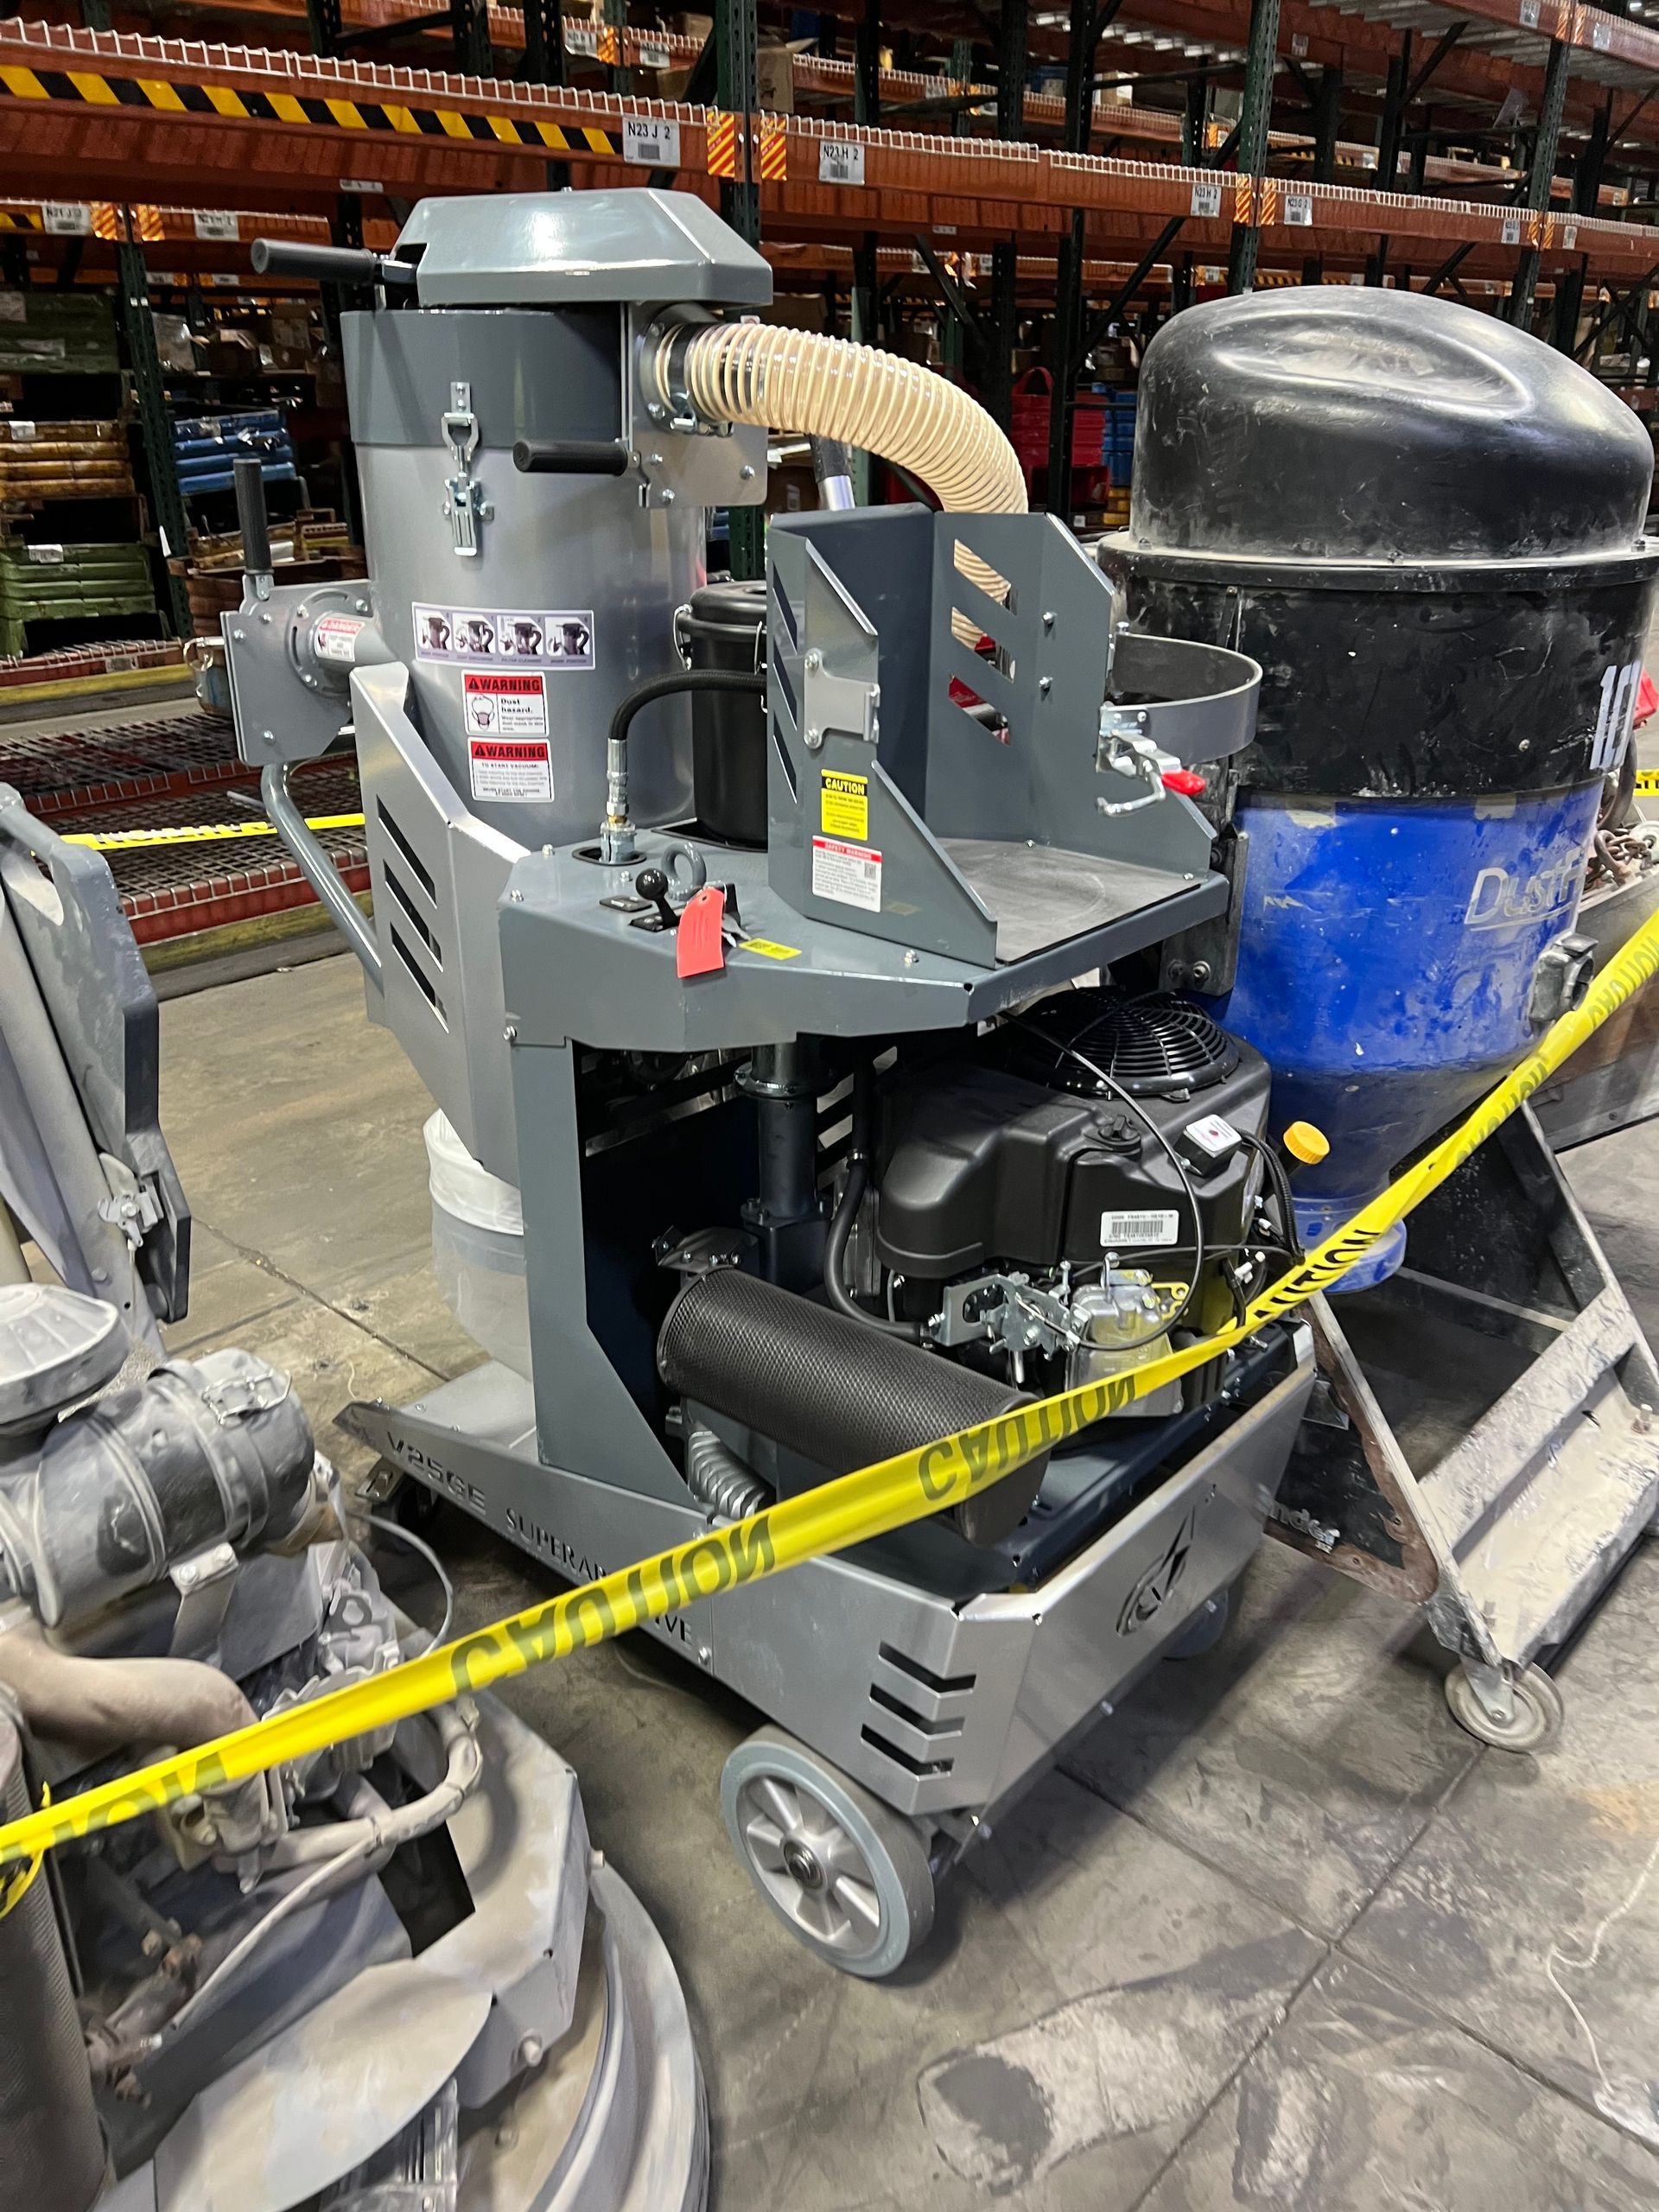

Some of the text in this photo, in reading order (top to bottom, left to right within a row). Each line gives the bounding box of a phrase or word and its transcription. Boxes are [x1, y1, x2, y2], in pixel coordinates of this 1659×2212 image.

[628, 121, 671, 140] N23 J 2
[854, 148, 859, 161] 2
[480, 677, 540, 691] WARNING
[486, 746, 545, 758] WARNING
[825, 778, 865, 796] CAUTION
